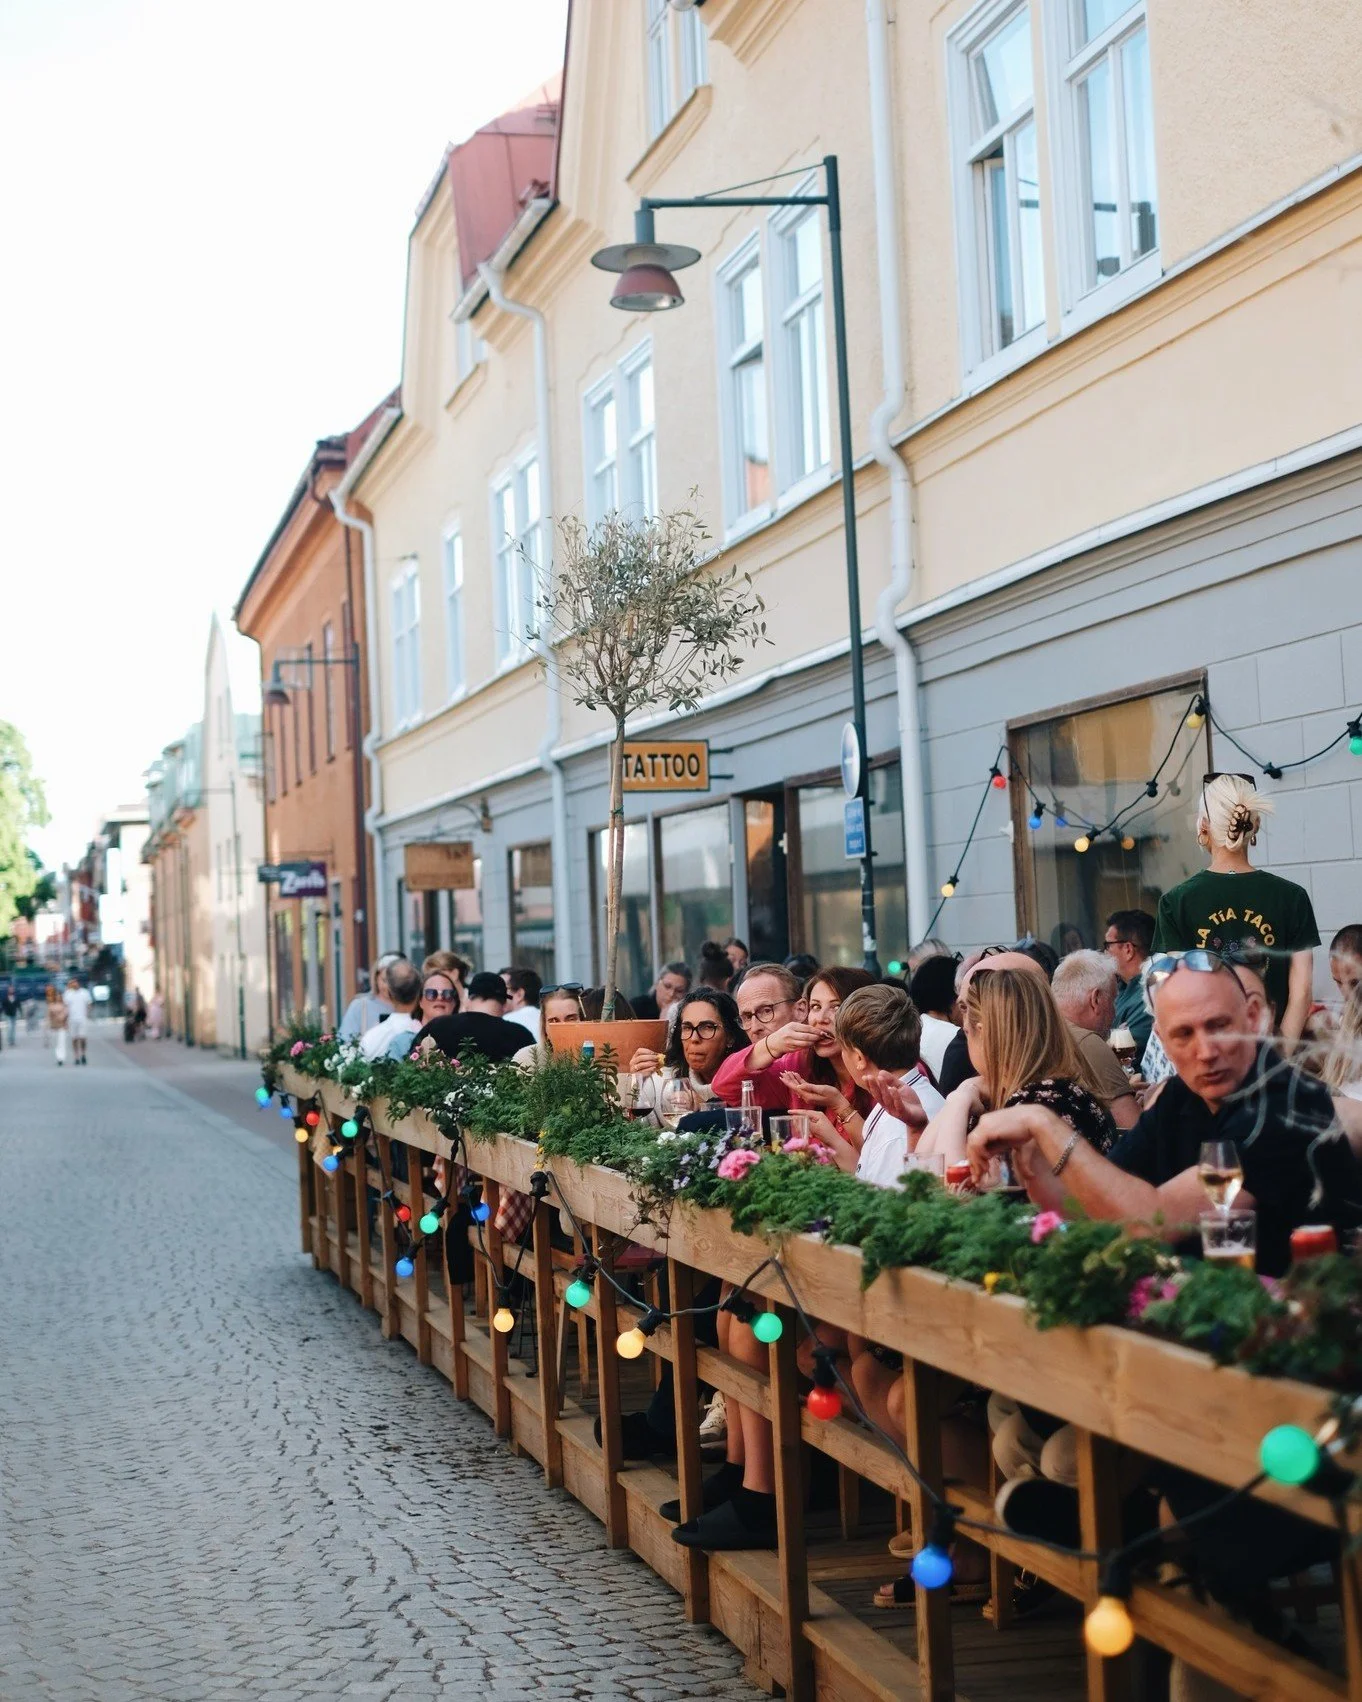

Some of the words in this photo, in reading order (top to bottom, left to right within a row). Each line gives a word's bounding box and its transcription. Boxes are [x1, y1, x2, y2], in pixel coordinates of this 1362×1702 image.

[622, 752, 700, 778] TATTOO
[1195, 928, 1211, 949] LA
[1243, 909, 1275, 947] TACO
